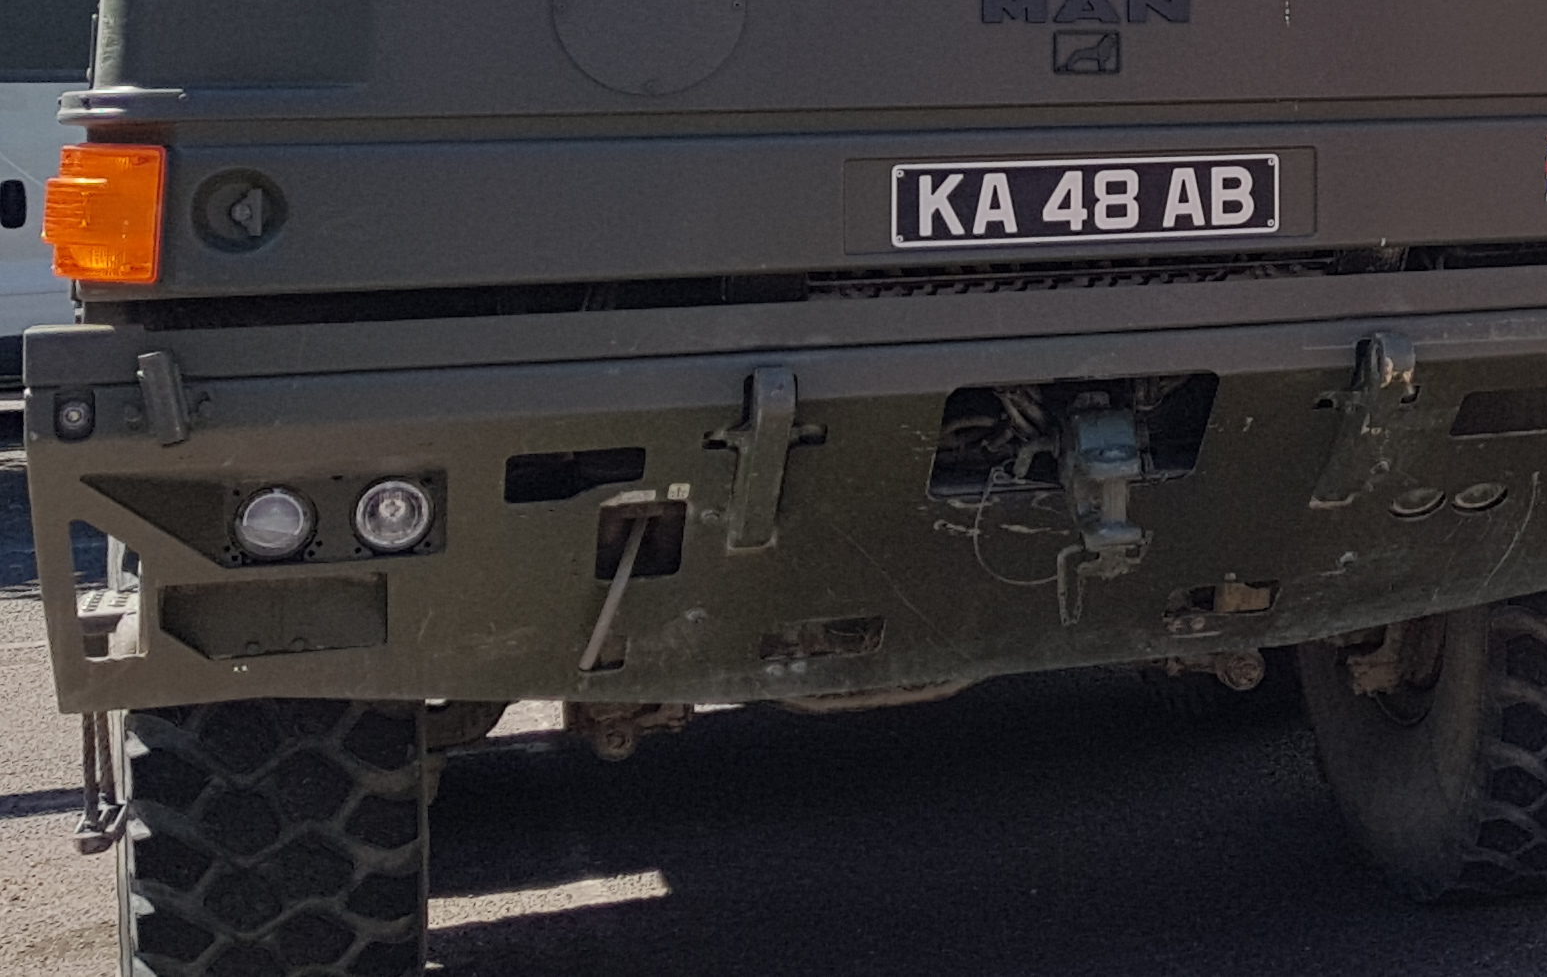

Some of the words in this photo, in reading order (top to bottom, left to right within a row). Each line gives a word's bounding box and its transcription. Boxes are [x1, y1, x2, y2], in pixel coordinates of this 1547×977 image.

[917, 172, 1019, 236] KA
[1042, 169, 1139, 231] 48
[1162, 166, 1256, 227] AB
